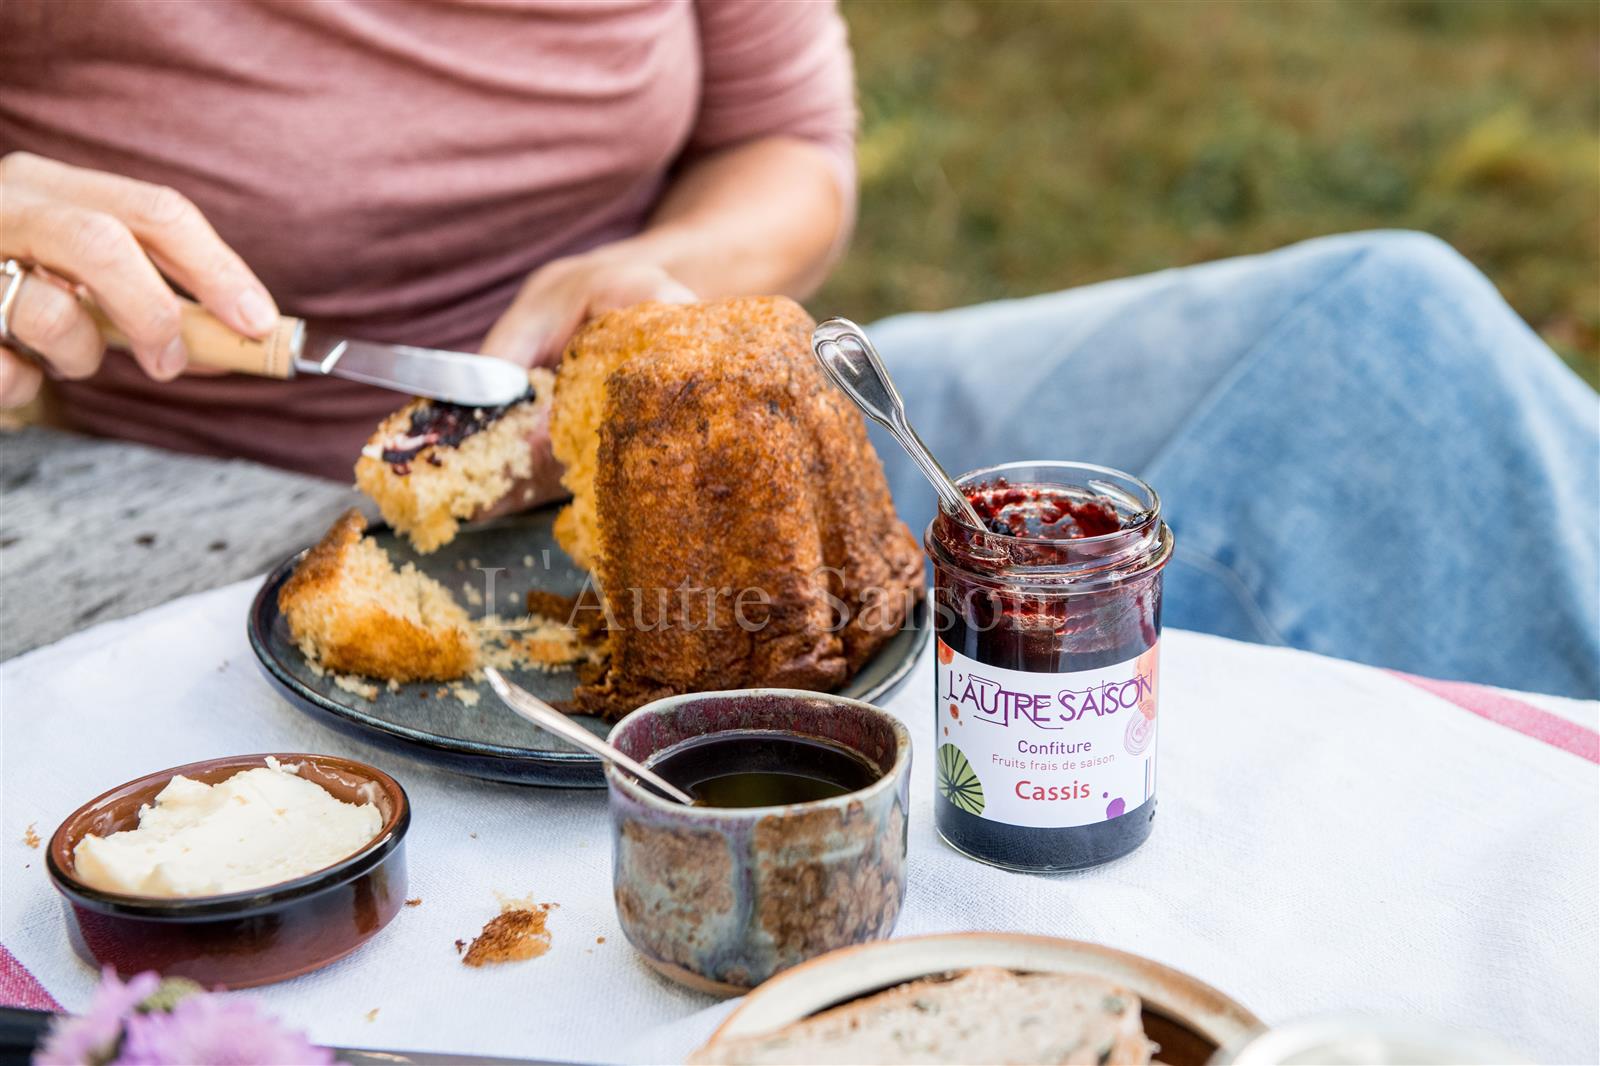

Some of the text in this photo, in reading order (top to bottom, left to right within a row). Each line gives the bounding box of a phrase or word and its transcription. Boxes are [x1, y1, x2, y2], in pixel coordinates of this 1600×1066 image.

[943, 669, 1153, 728] L'AUTRE SAISON
[1017, 739, 1092, 755] Confiture
[992, 753, 1115, 771] Fruits frais de saison
[1015, 779, 1091, 801] Cassis
